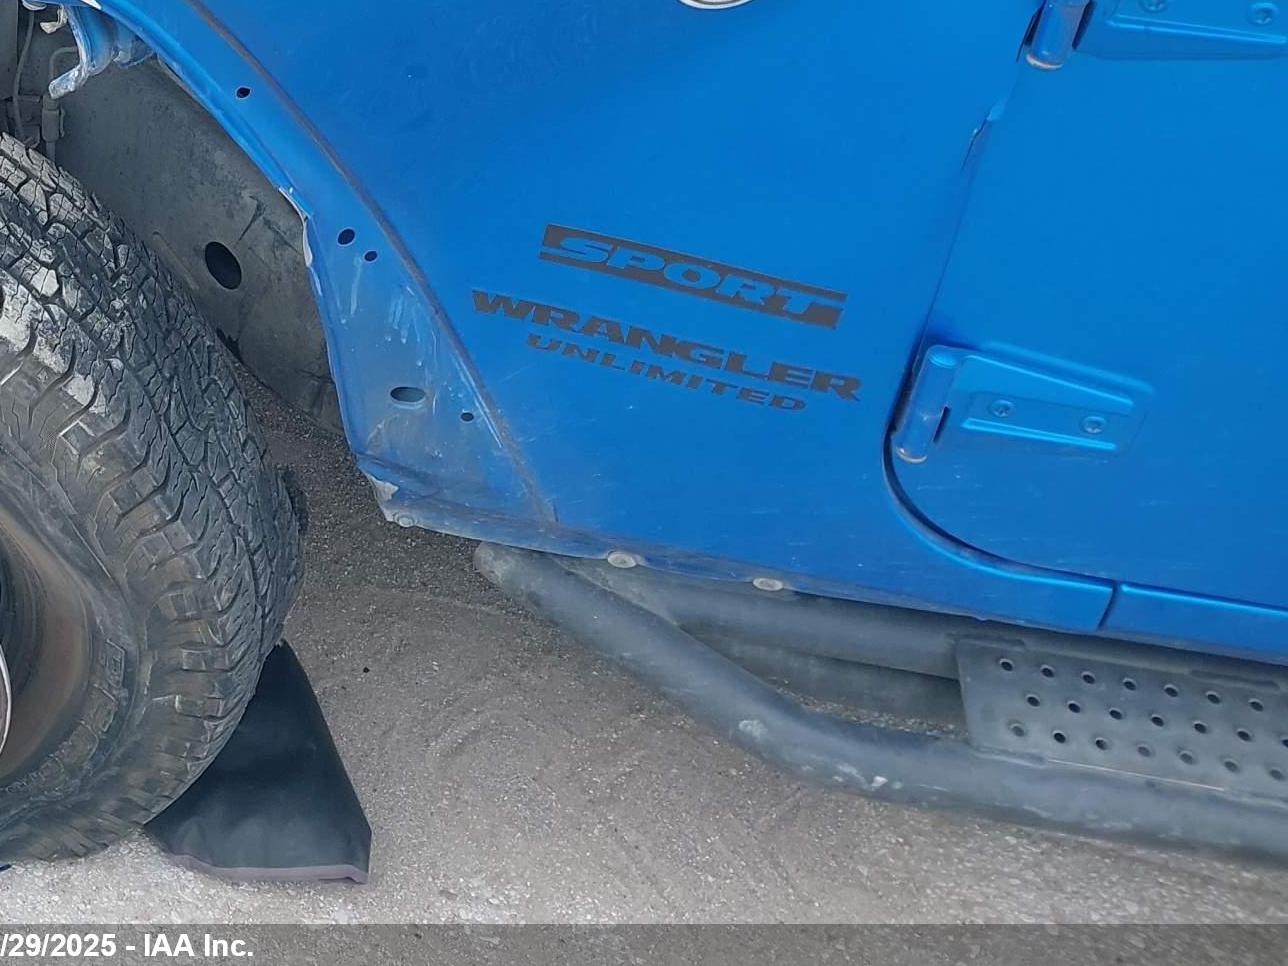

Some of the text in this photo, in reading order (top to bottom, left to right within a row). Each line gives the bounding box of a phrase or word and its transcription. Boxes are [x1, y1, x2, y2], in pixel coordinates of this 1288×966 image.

[540, 228, 848, 326] SPORT
[471, 289, 861, 402] WRANGLER
[526, 333, 806, 411] UNLIMITED
